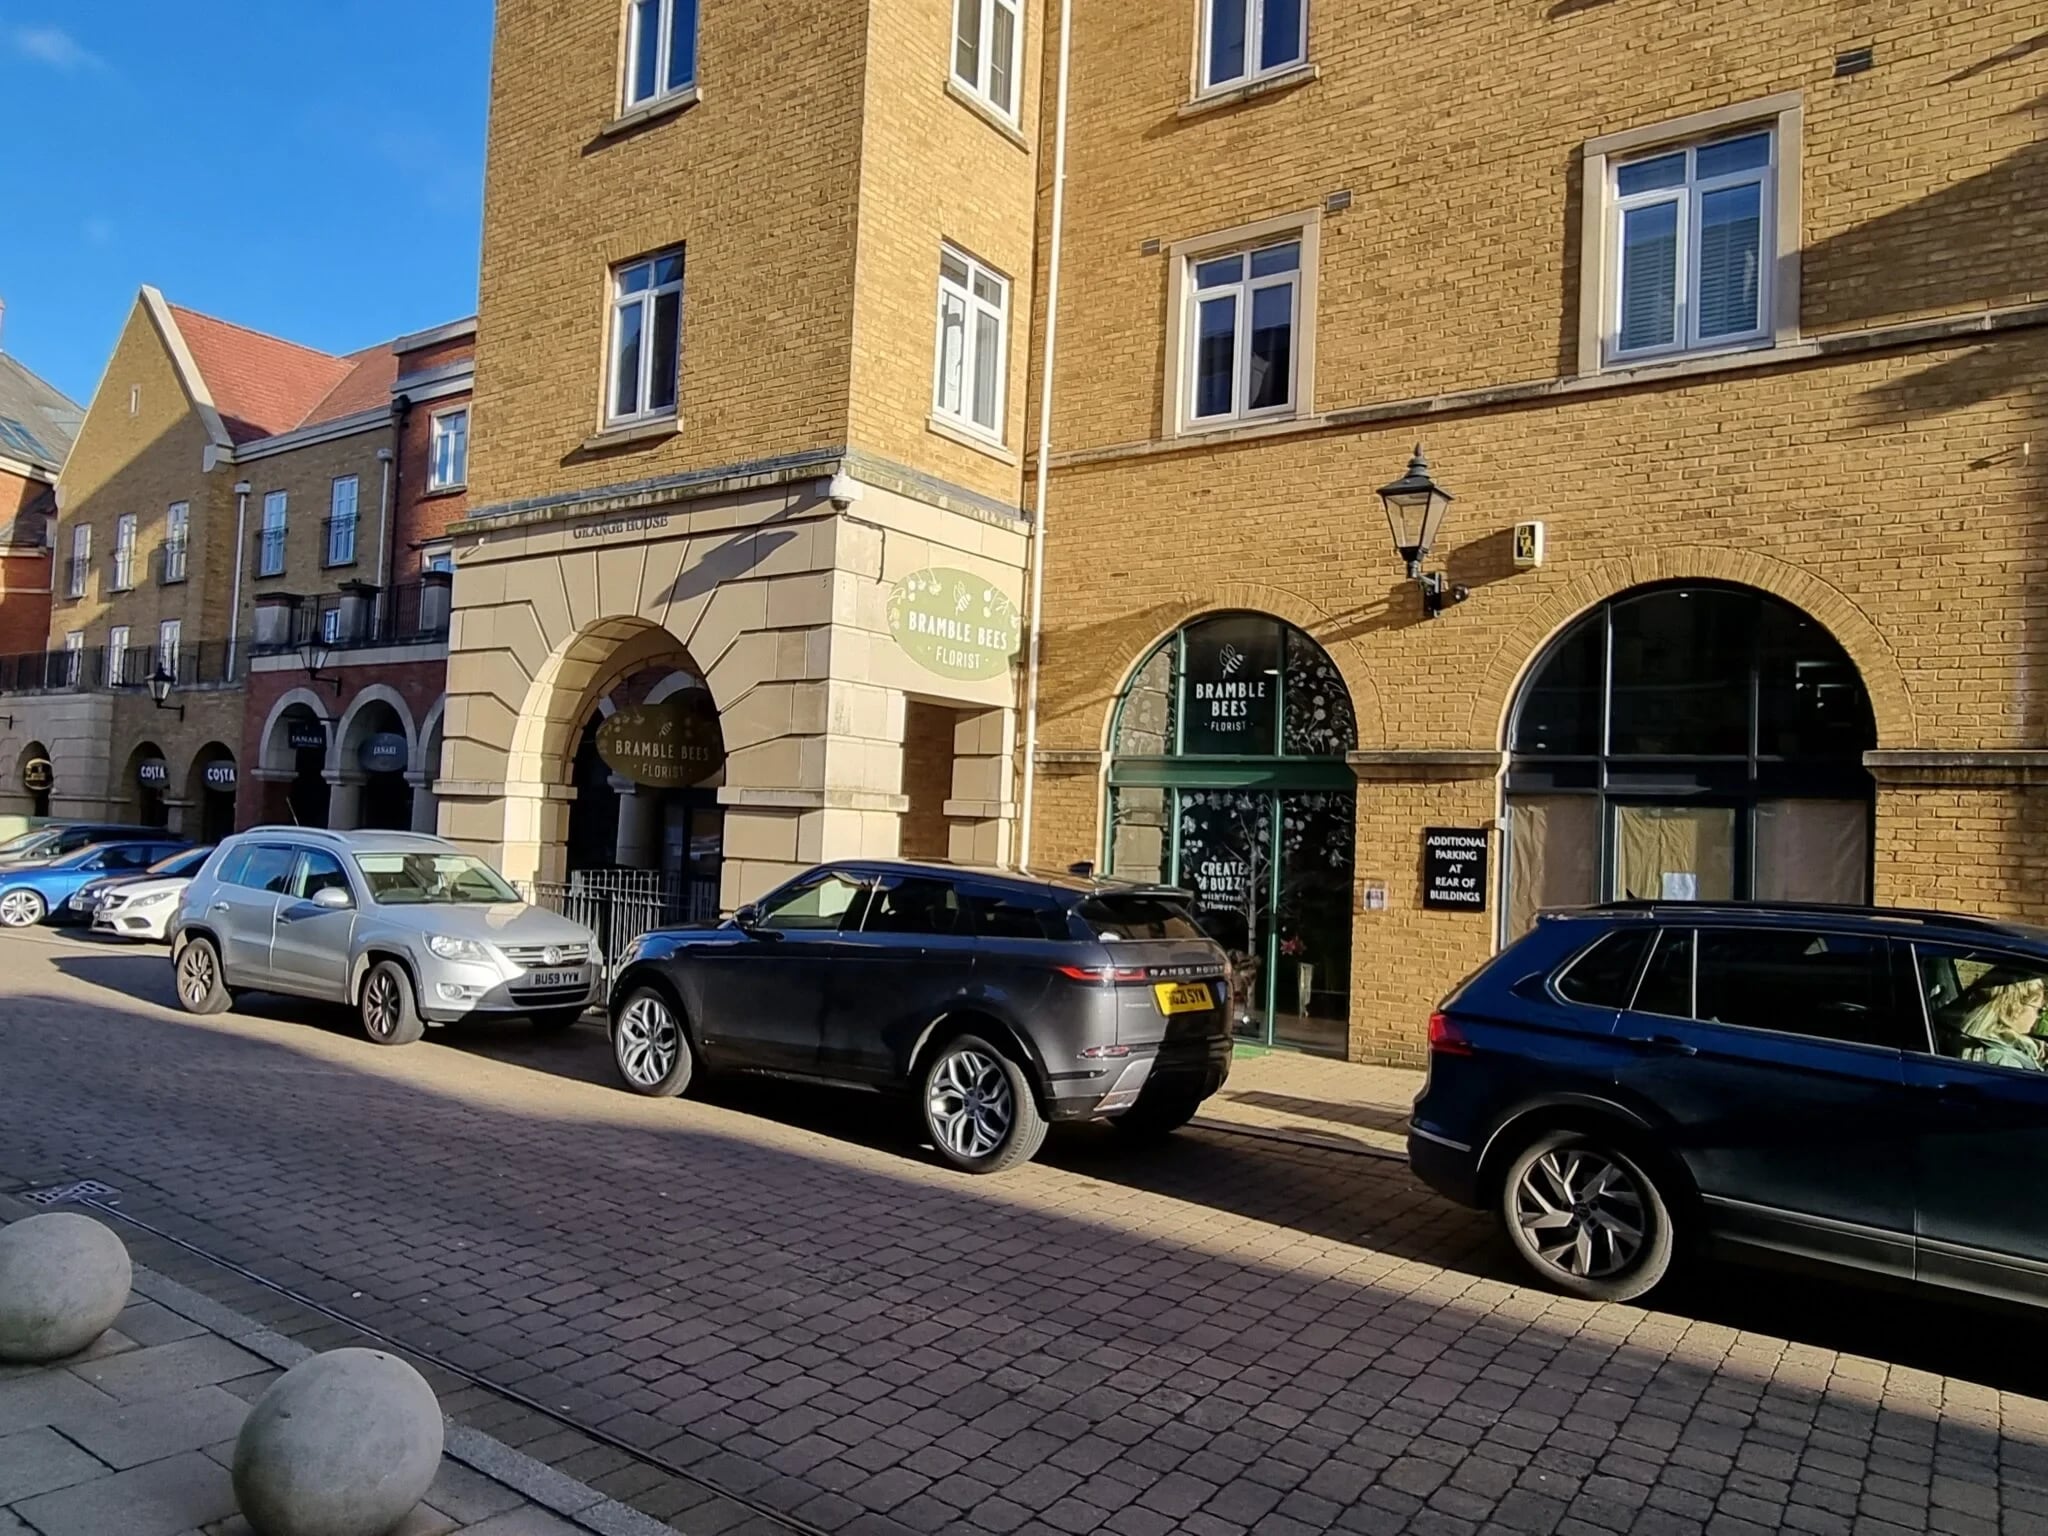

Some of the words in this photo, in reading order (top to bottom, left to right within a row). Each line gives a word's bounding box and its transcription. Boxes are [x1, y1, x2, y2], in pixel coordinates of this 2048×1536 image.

[573, 520, 623, 539] GRANGE
[626, 514, 669, 533] HOUSE
[908, 611, 971, 643] BRAMBLE
[977, 627, 1008, 651] BEES
[936, 645, 981, 669] FLORIST
[1195, 682, 1266, 699] BRAMBLE
[1211, 700, 1248, 717] BEES
[1210, 720, 1246, 732] FLORIST
[615, 740, 675, 759] BRAMBLE
[681, 745, 709, 761] BEES
[141, 765, 165, 779] COSTA
[207, 767, 235, 783] COSTA
[641, 763, 684, 779] FLORIST
[1427, 836, 1487, 848] ADDITIONAL
[1435, 850, 1478, 861] PARKING
[1201, 861, 1244, 876] CREATE
[1448, 864, 1463, 874] AT
[1435, 877, 1459, 887] REAR
[1461, 878, 1476, 888] OF
[1430, 889, 1481, 902] BUILDINGS
